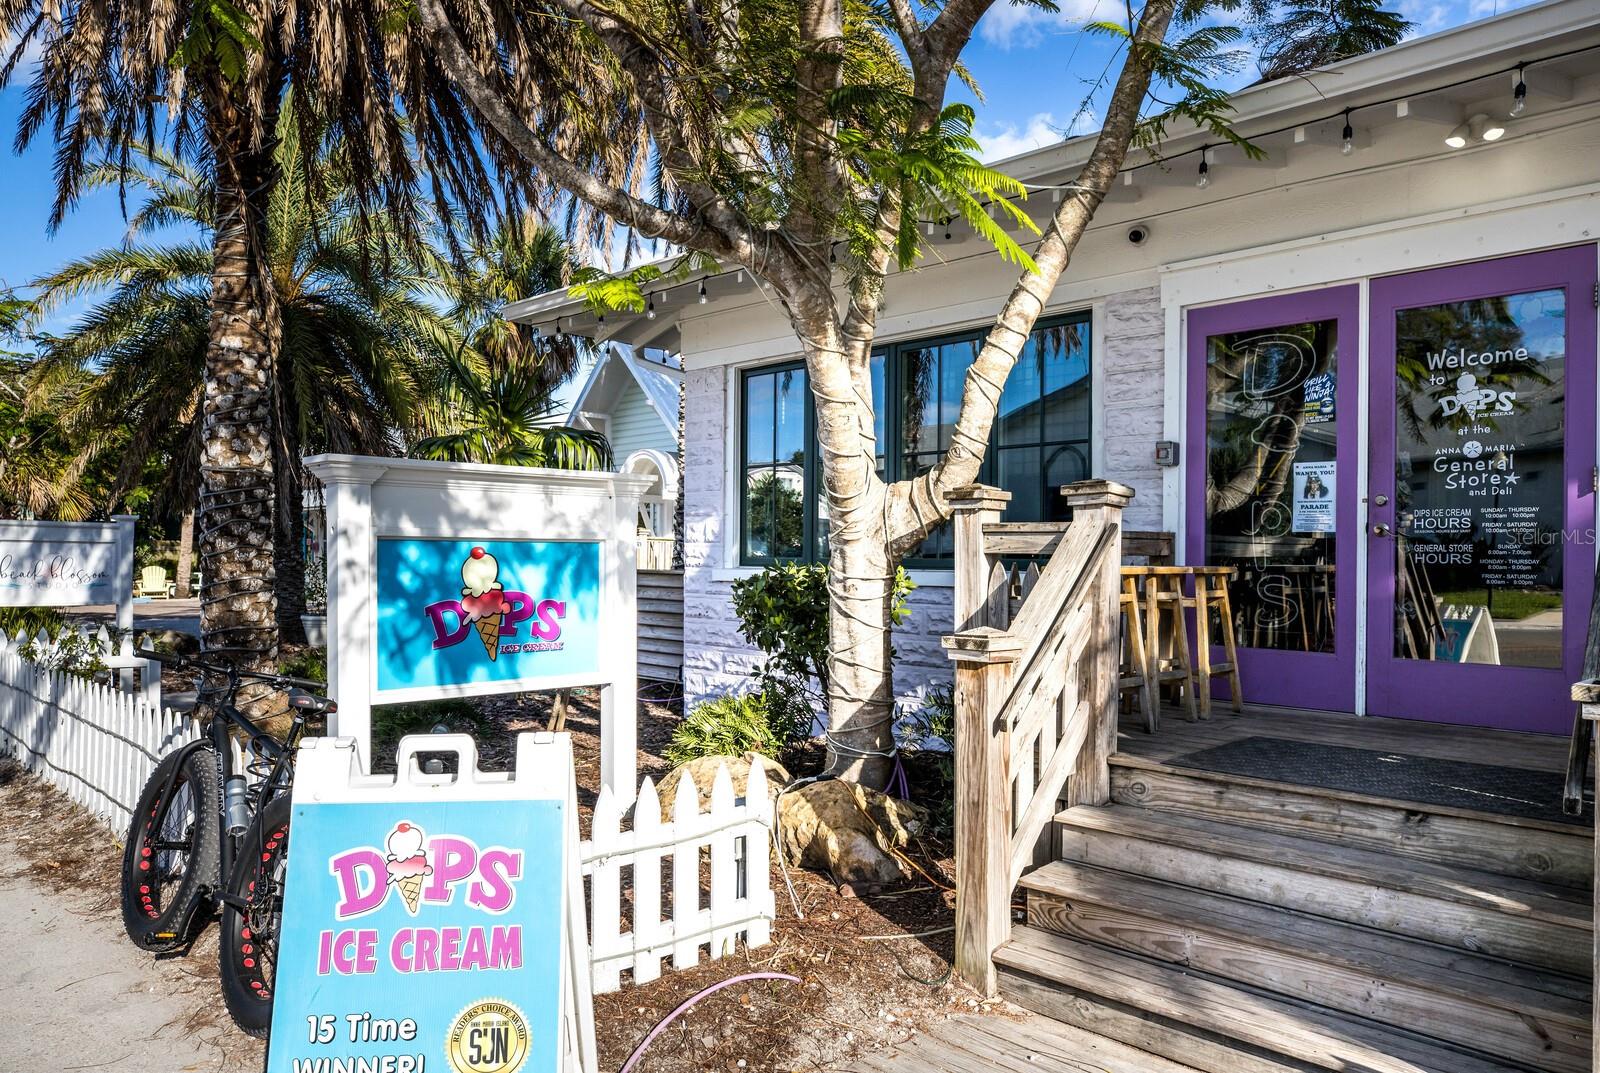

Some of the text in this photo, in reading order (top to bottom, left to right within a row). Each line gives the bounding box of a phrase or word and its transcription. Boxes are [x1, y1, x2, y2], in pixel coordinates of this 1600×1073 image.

[1426, 347, 1528, 371] Welcome
[1304, 374, 1329, 388] GRILL
[1429, 374, 1446, 386] to
[1458, 424, 1491, 436] at the
[1435, 444, 1516, 455] ANNA MARIA
[1433, 454, 1514, 473] General
[1445, 472, 1501, 489] Store
[1469, 486, 1512, 496] and Deli
[1413, 508, 1472, 517] DIPS ICE CREAM
[1414, 517, 1471, 529] HOURS
[1413, 544, 1474, 552] GENERAL STORE
[1414, 553, 1472, 564] HOURS
[0, 554, 110, 585] beach blossom
[499, 641, 564, 654] ICE CREAM
[318, 925, 524, 976] ICE CREAM
[306, 1011, 418, 1045] 15 Time
[482, 1004, 511, 1016] CHOICE
[510, 1013, 526, 1041] AWARD
